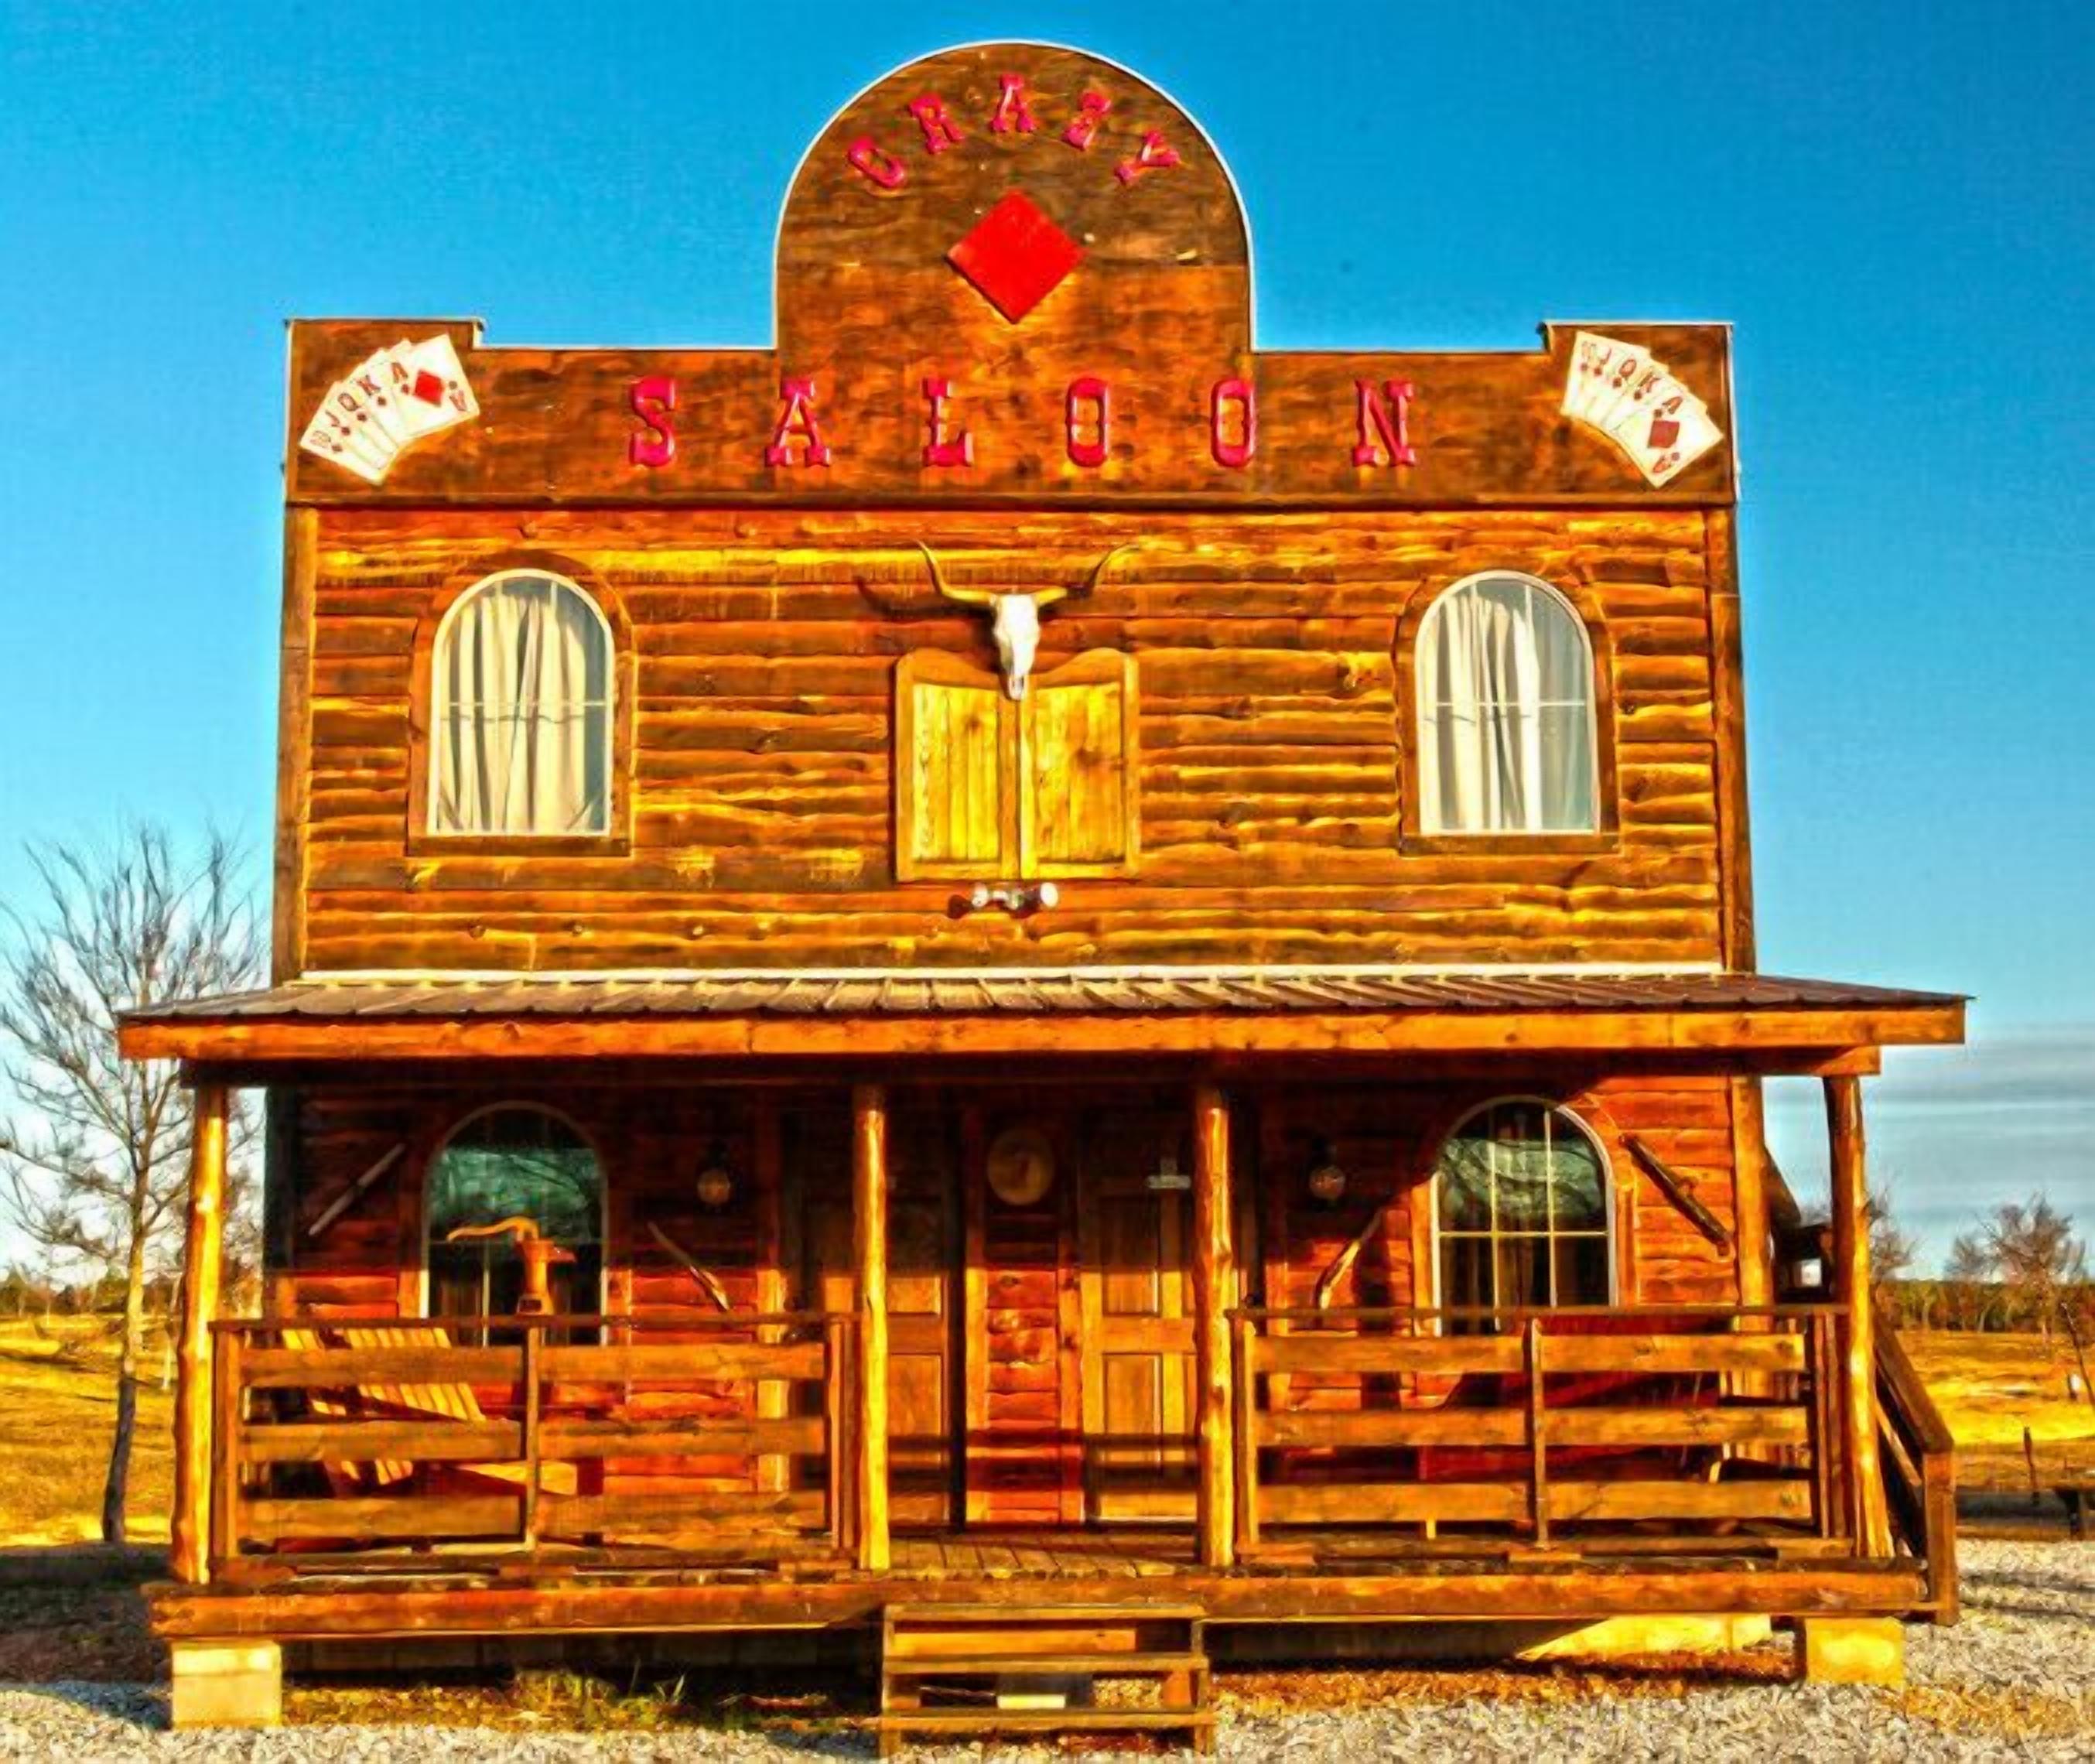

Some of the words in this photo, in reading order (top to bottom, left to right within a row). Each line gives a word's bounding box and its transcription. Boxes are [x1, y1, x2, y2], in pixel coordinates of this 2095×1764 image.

[847, 72, 1181, 189] CRAZY
[357, 375, 381, 396] K
[391, 362, 408, 384] A
[628, 378, 1417, 467] SALOON
